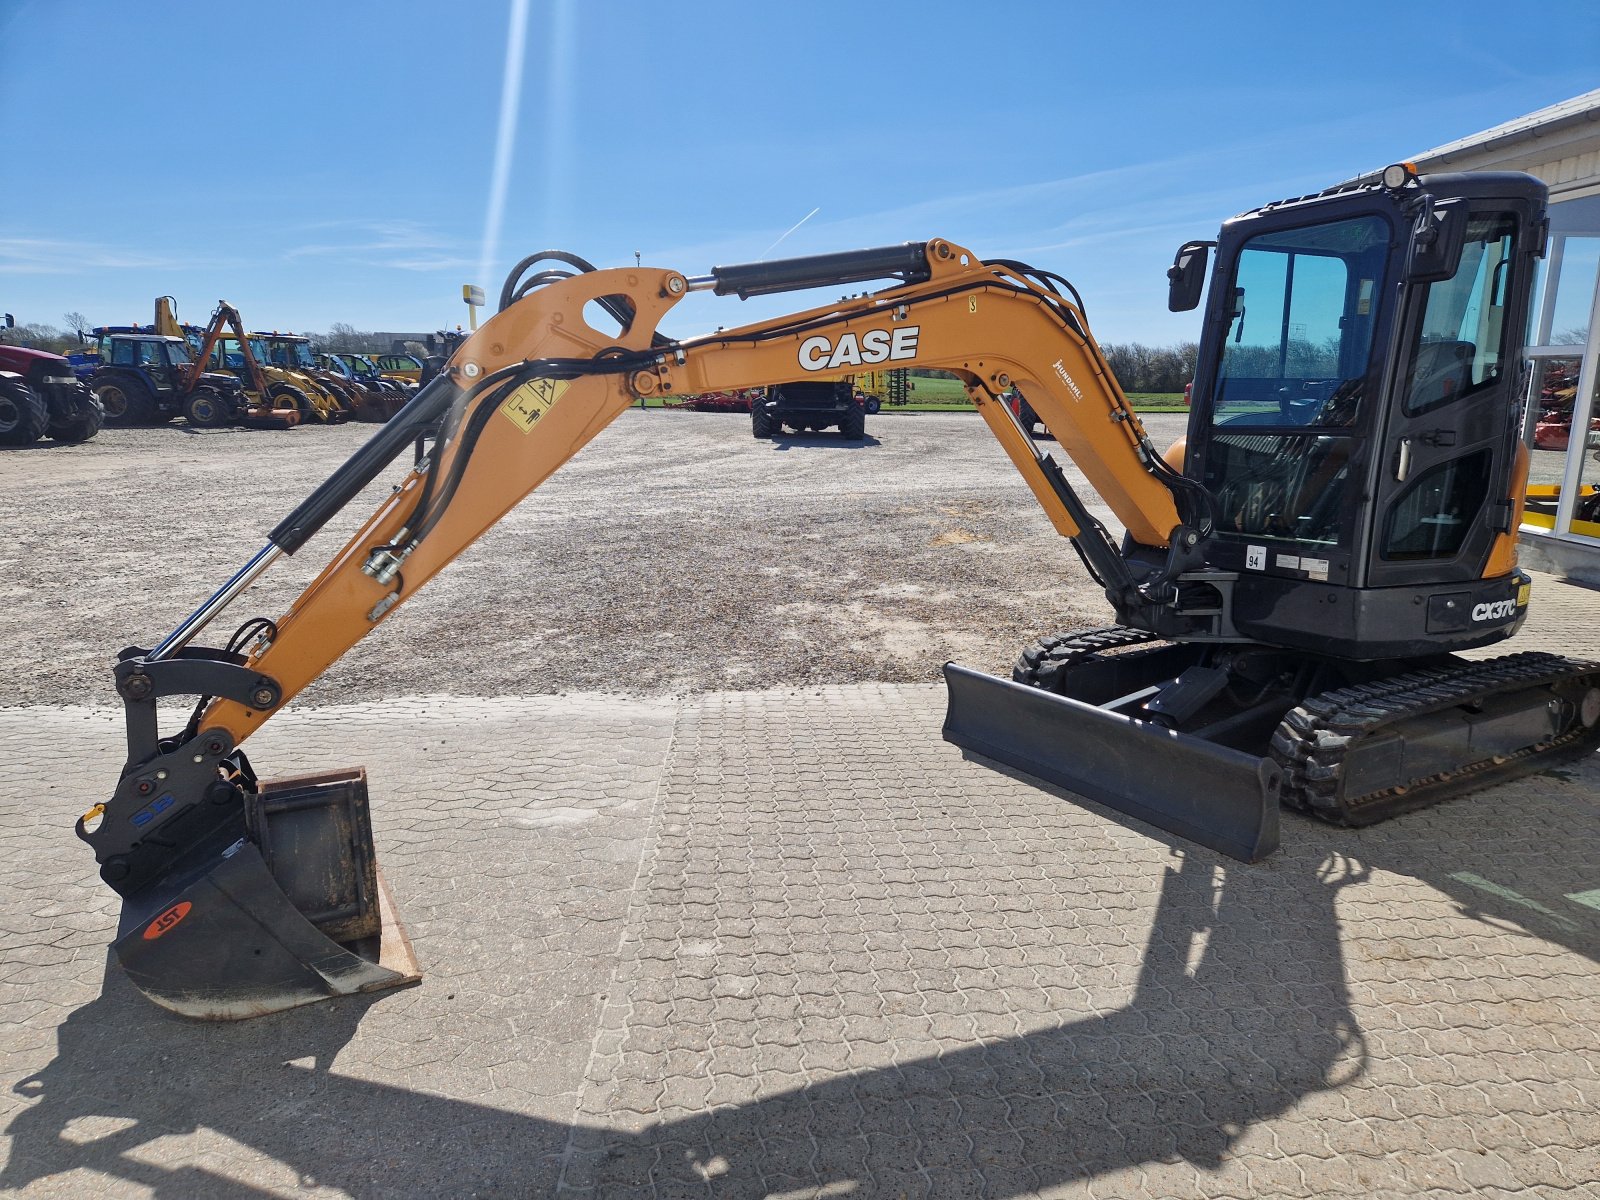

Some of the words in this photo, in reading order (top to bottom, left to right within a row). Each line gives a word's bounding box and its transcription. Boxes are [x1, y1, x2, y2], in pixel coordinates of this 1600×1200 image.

[798, 326, 921, 371] CASE
[1248, 555, 1259, 568] 94
[1471, 598, 1516, 621] CX37C
